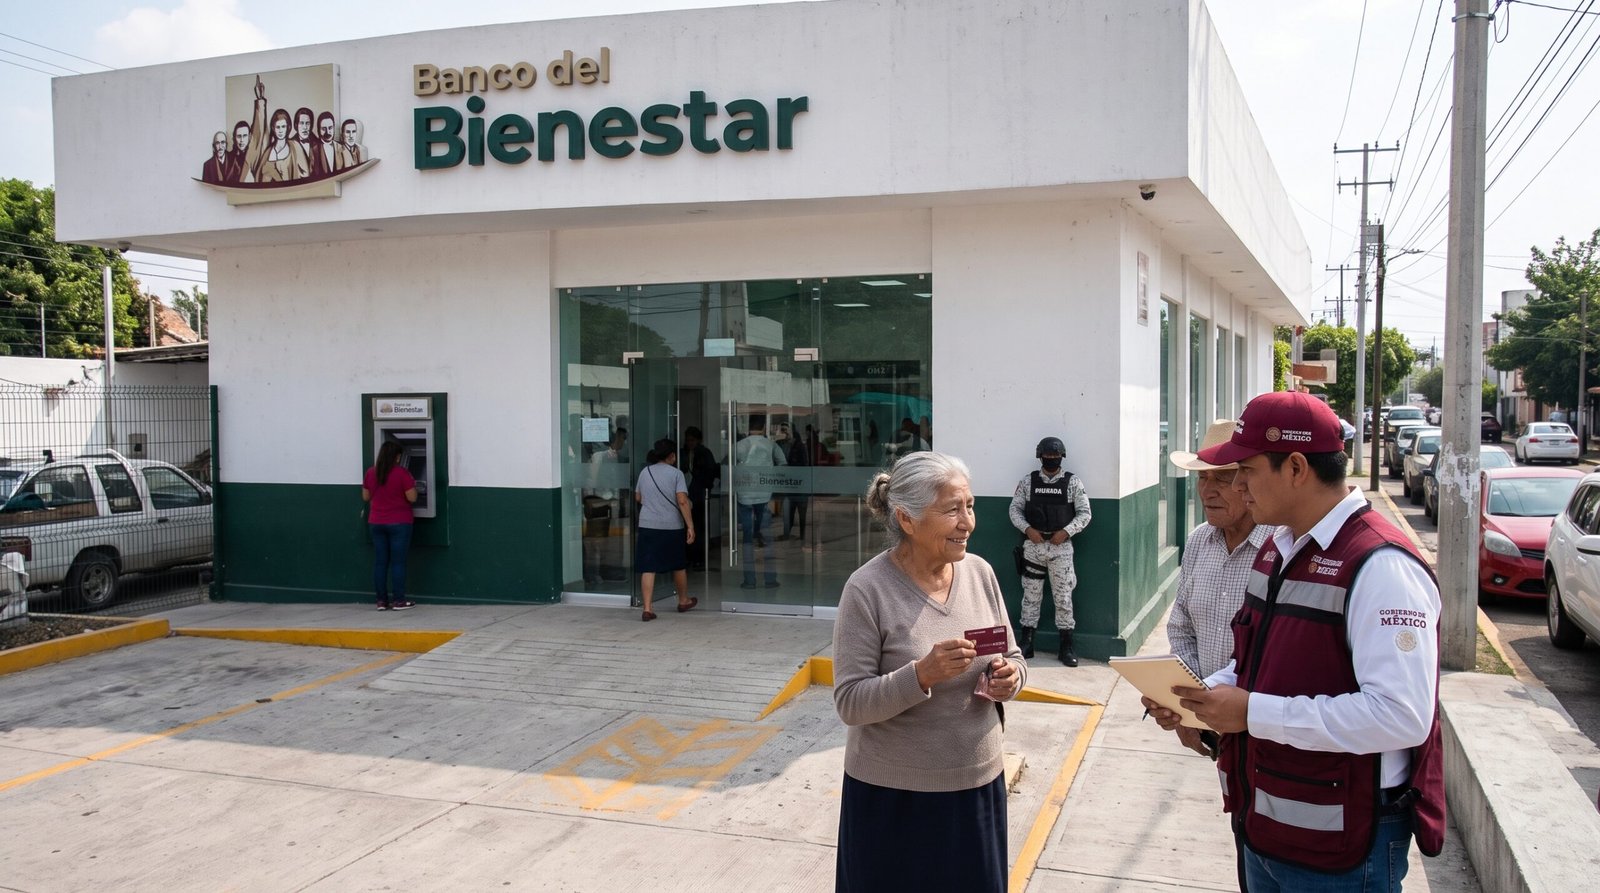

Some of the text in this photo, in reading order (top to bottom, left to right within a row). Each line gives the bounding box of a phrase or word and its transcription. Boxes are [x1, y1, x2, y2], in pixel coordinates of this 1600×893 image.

[413, 46, 611, 97] Banco del
[413, 90, 810, 171] Bienestar
[1281, 432, 1312, 442] MÉXICO
[1379, 609, 1427, 619] GOBIERNO DE
[1380, 614, 1427, 629] MÉXICO
